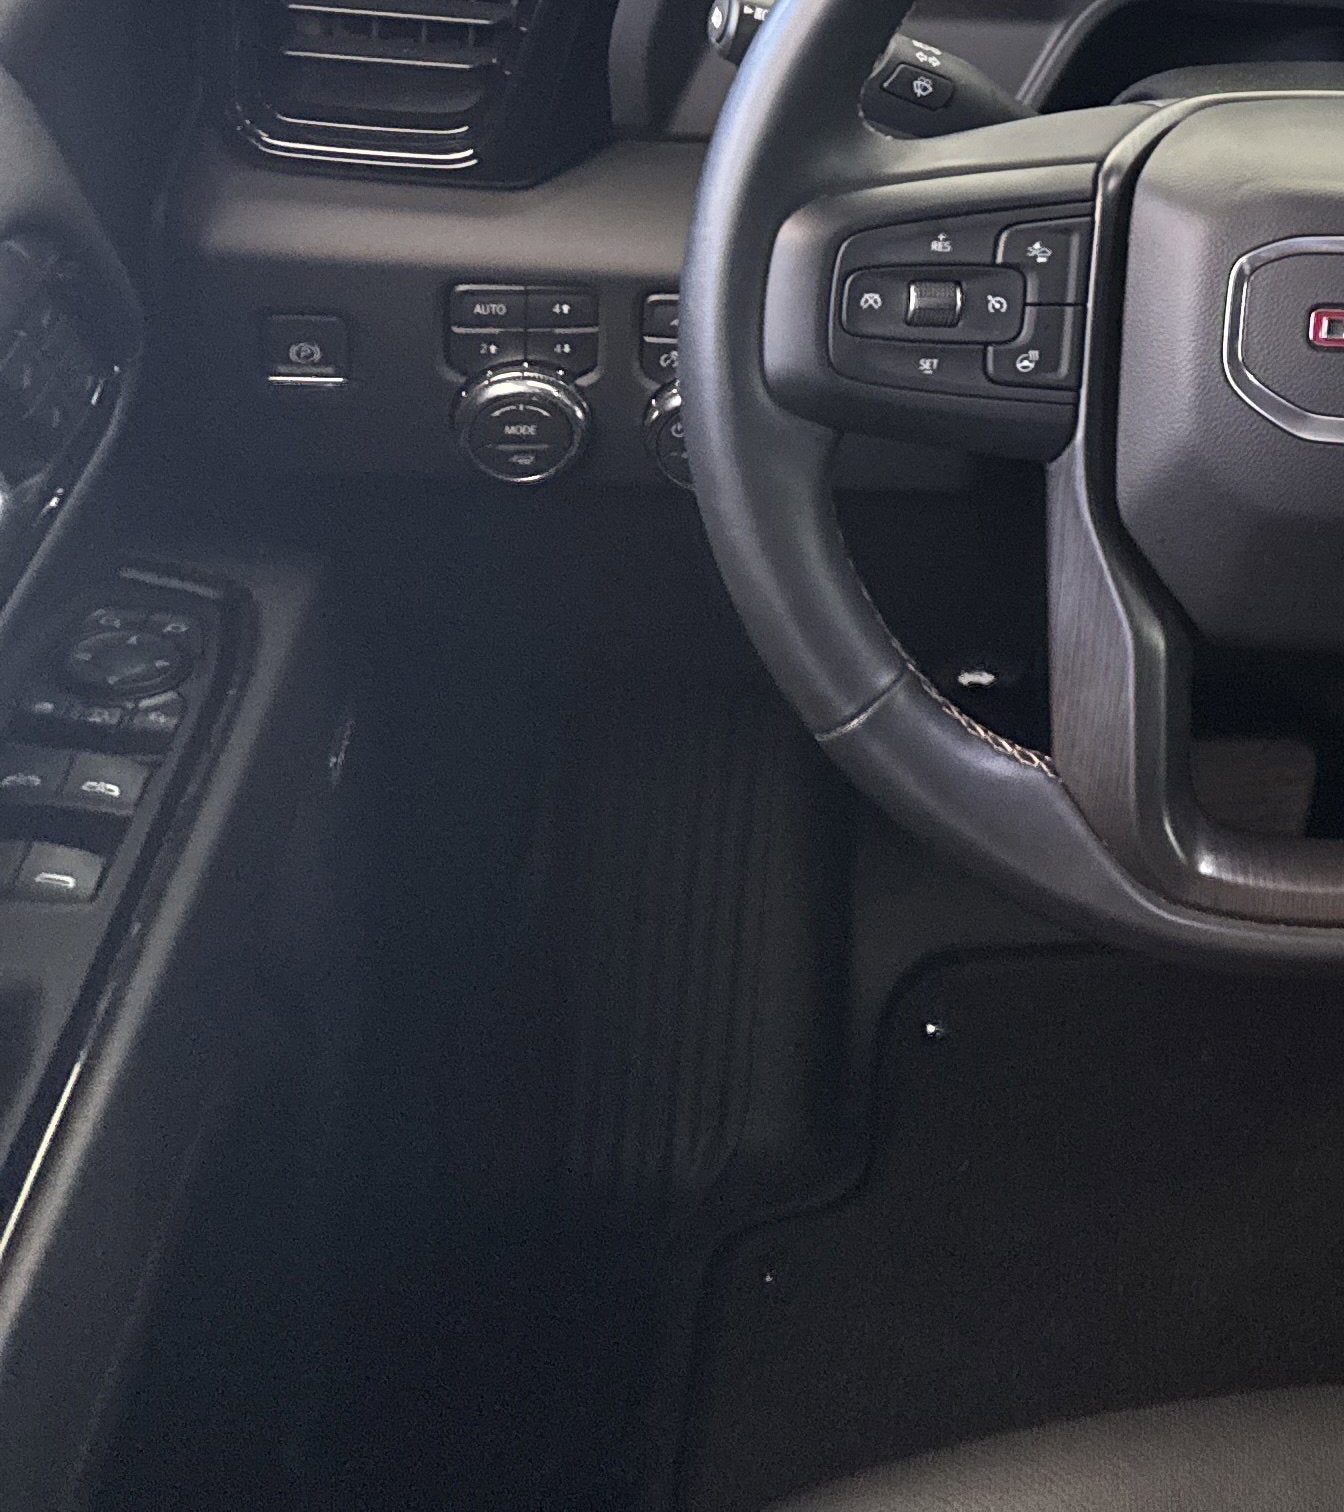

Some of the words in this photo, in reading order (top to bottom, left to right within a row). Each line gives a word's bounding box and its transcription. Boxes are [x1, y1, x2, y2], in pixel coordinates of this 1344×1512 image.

[931, 240, 951, 252] RES
[473, 303, 507, 315] AUTO
[918, 358, 939, 370] SET
[503, 424, 538, 436] MODE
